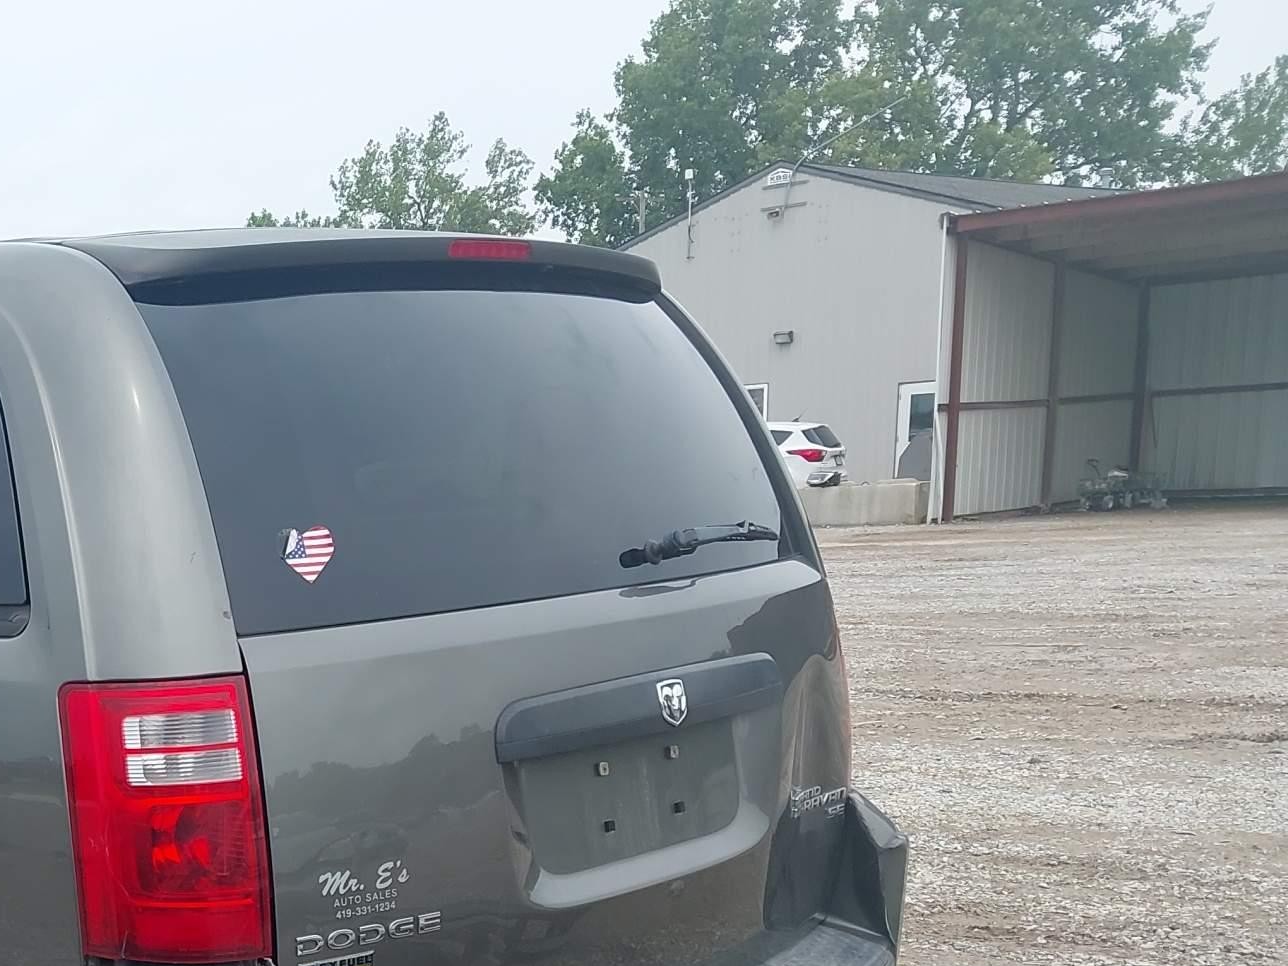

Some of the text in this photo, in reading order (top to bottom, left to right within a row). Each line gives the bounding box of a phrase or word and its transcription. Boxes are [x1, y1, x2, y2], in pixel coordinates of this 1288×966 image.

[319, 860, 410, 896] Mr. E's
[334, 888, 398, 908] AUTO SALES
[336, 901, 396, 919] 419-331-1234
[296, 911, 441, 956] DODGE
